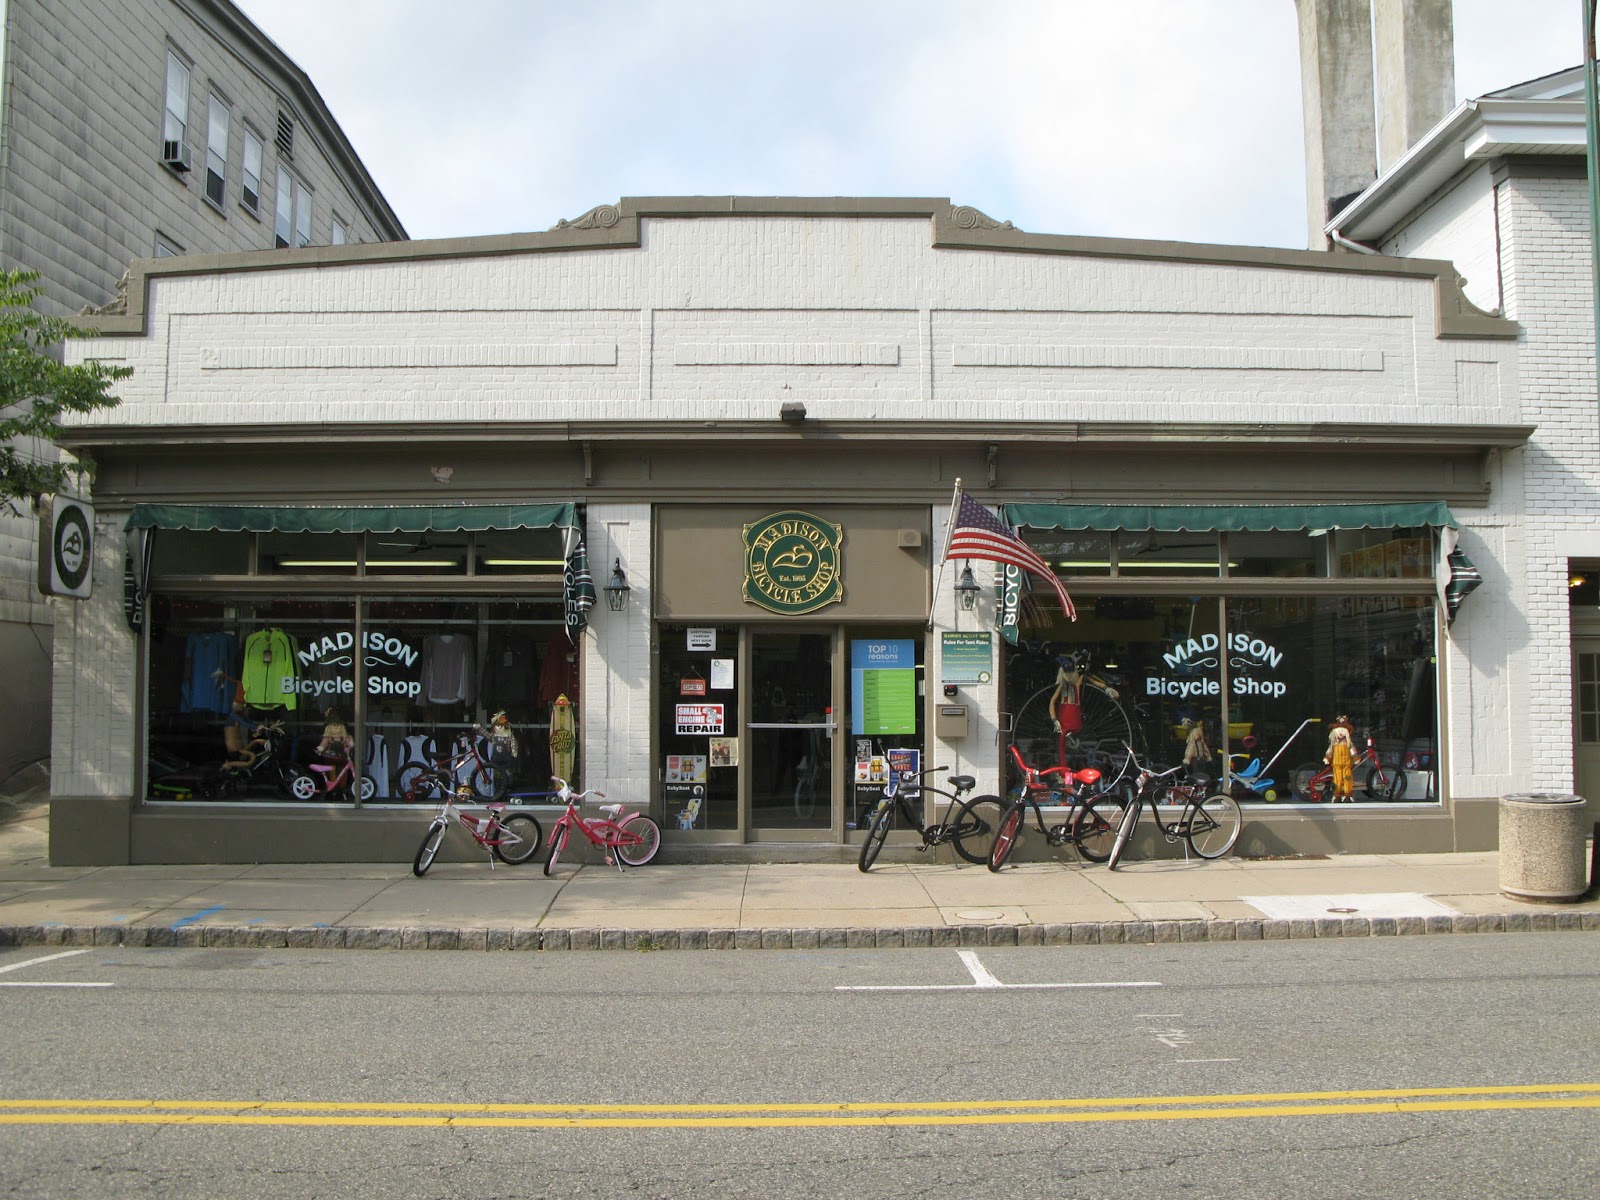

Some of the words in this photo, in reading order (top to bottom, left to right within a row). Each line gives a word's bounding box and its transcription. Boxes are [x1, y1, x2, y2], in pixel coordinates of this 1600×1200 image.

[756, 522, 829, 551] MADISON
[752, 561, 802, 603] BICYCLE
[805, 561, 833, 598] SHOP
[1004, 563, 1019, 626] BICYC
[297, 631, 419, 667] MADISON
[868, 645, 886, 653] TOP
[888, 645, 899, 653] 10
[1162, 632, 1284, 669] MADISON
[281, 676, 354, 697] Bicycle
[367, 676, 422, 698] Shop
[1146, 677, 1220, 699] Bicycle
[1232, 677, 1287, 698] Shop
[678, 707, 702, 715] SMALL
[678, 716, 706, 724] ENGINE
